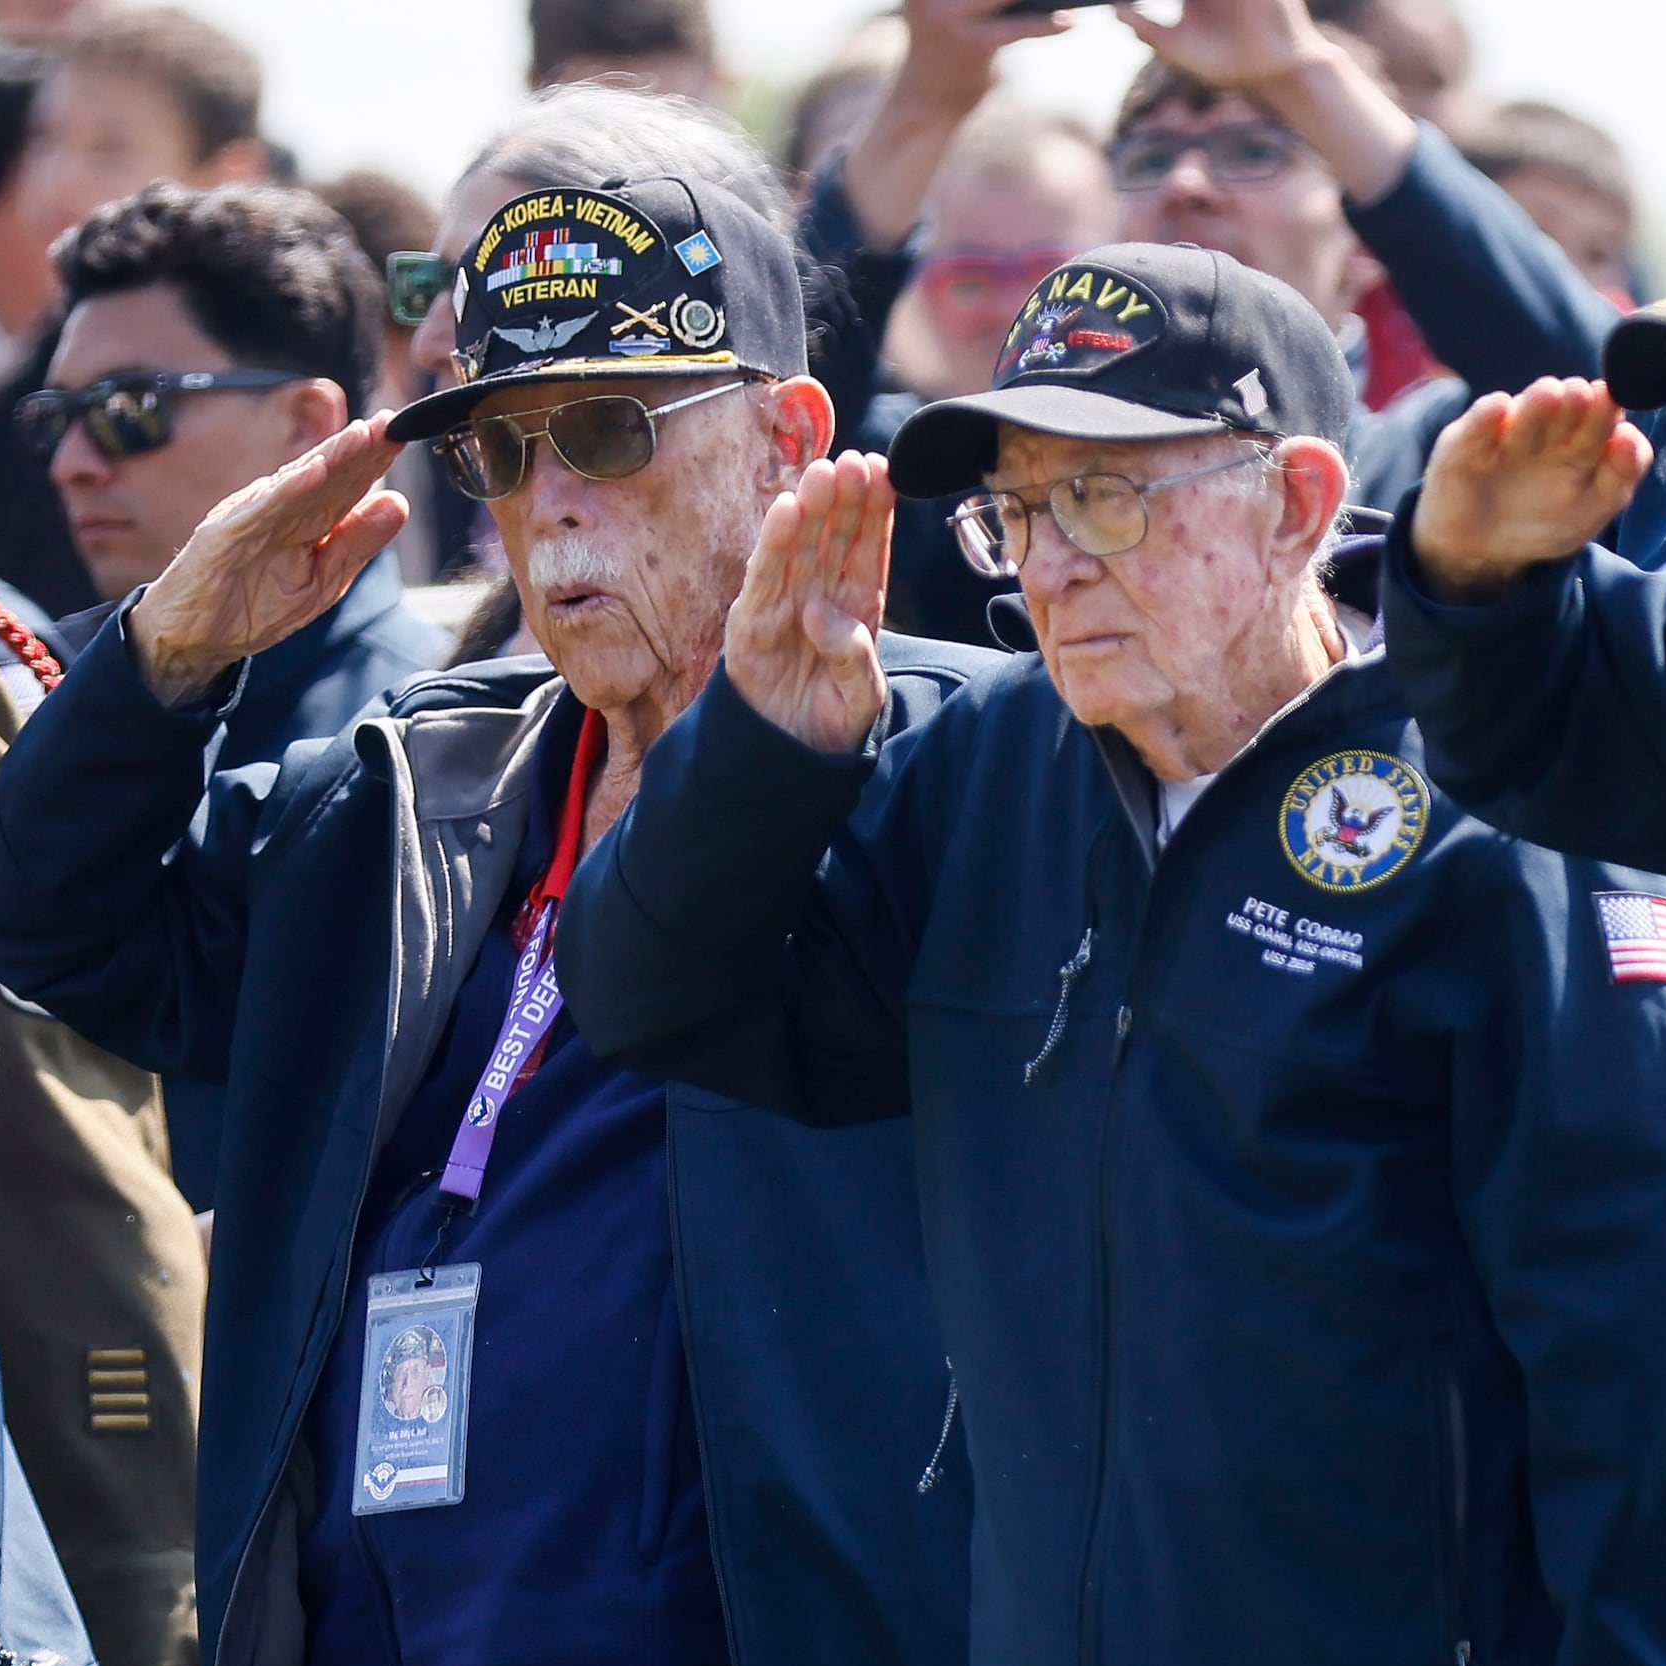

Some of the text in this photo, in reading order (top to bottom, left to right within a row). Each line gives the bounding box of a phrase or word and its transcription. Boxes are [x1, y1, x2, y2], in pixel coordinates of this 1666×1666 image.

[501, 278, 598, 309] VETERAN
[1047, 271, 1151, 324] NAVY
[1067, 330, 1133, 352] VETERAN
[1291, 756, 1421, 849] UNITED STATES
[1298, 850, 1365, 885] NAVY
[1226, 911, 1253, 931] USS
[1243, 896, 1290, 926] PETE
[1262, 949, 1287, 965] USS
[485, 1022, 531, 1091] BEST
